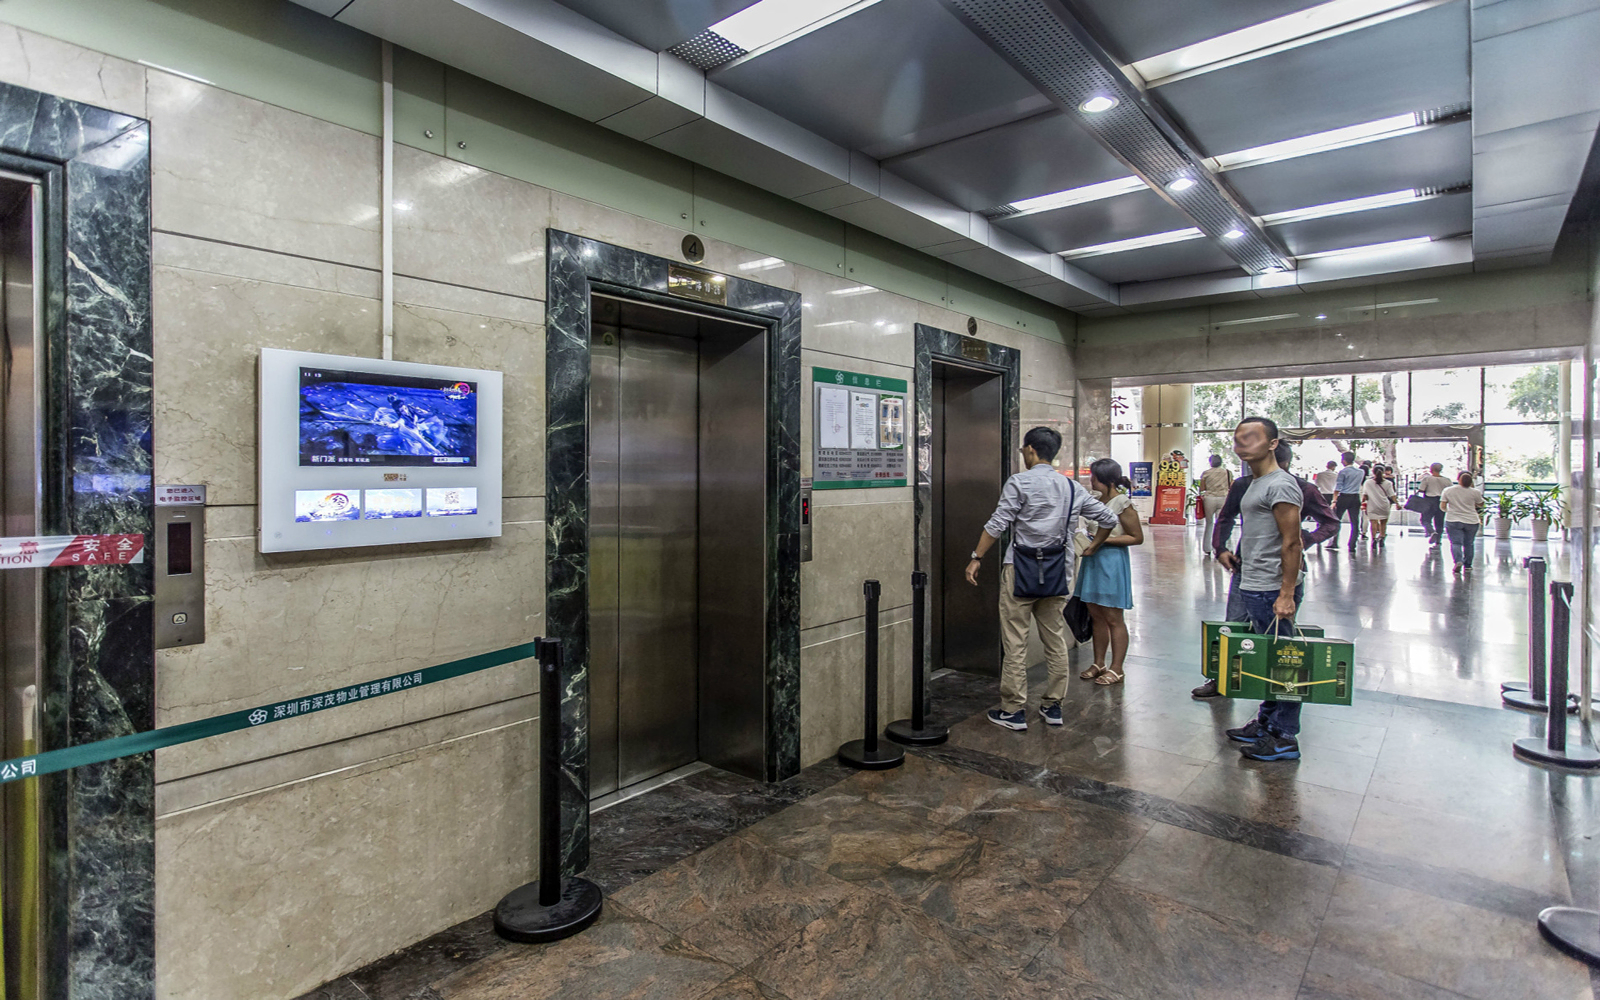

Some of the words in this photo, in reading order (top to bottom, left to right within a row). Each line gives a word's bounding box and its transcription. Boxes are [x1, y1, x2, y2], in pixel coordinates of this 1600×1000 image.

[688, 241, 698, 257] 4
[1160, 460, 1180, 472] 9.9
[83, 537, 133, 552] 安全
[72, 552, 126, 562] SAFE
[273, 672, 422, 719] 深圳市深茂物业管理有限公司
[1, 759, 36, 779] 公司
